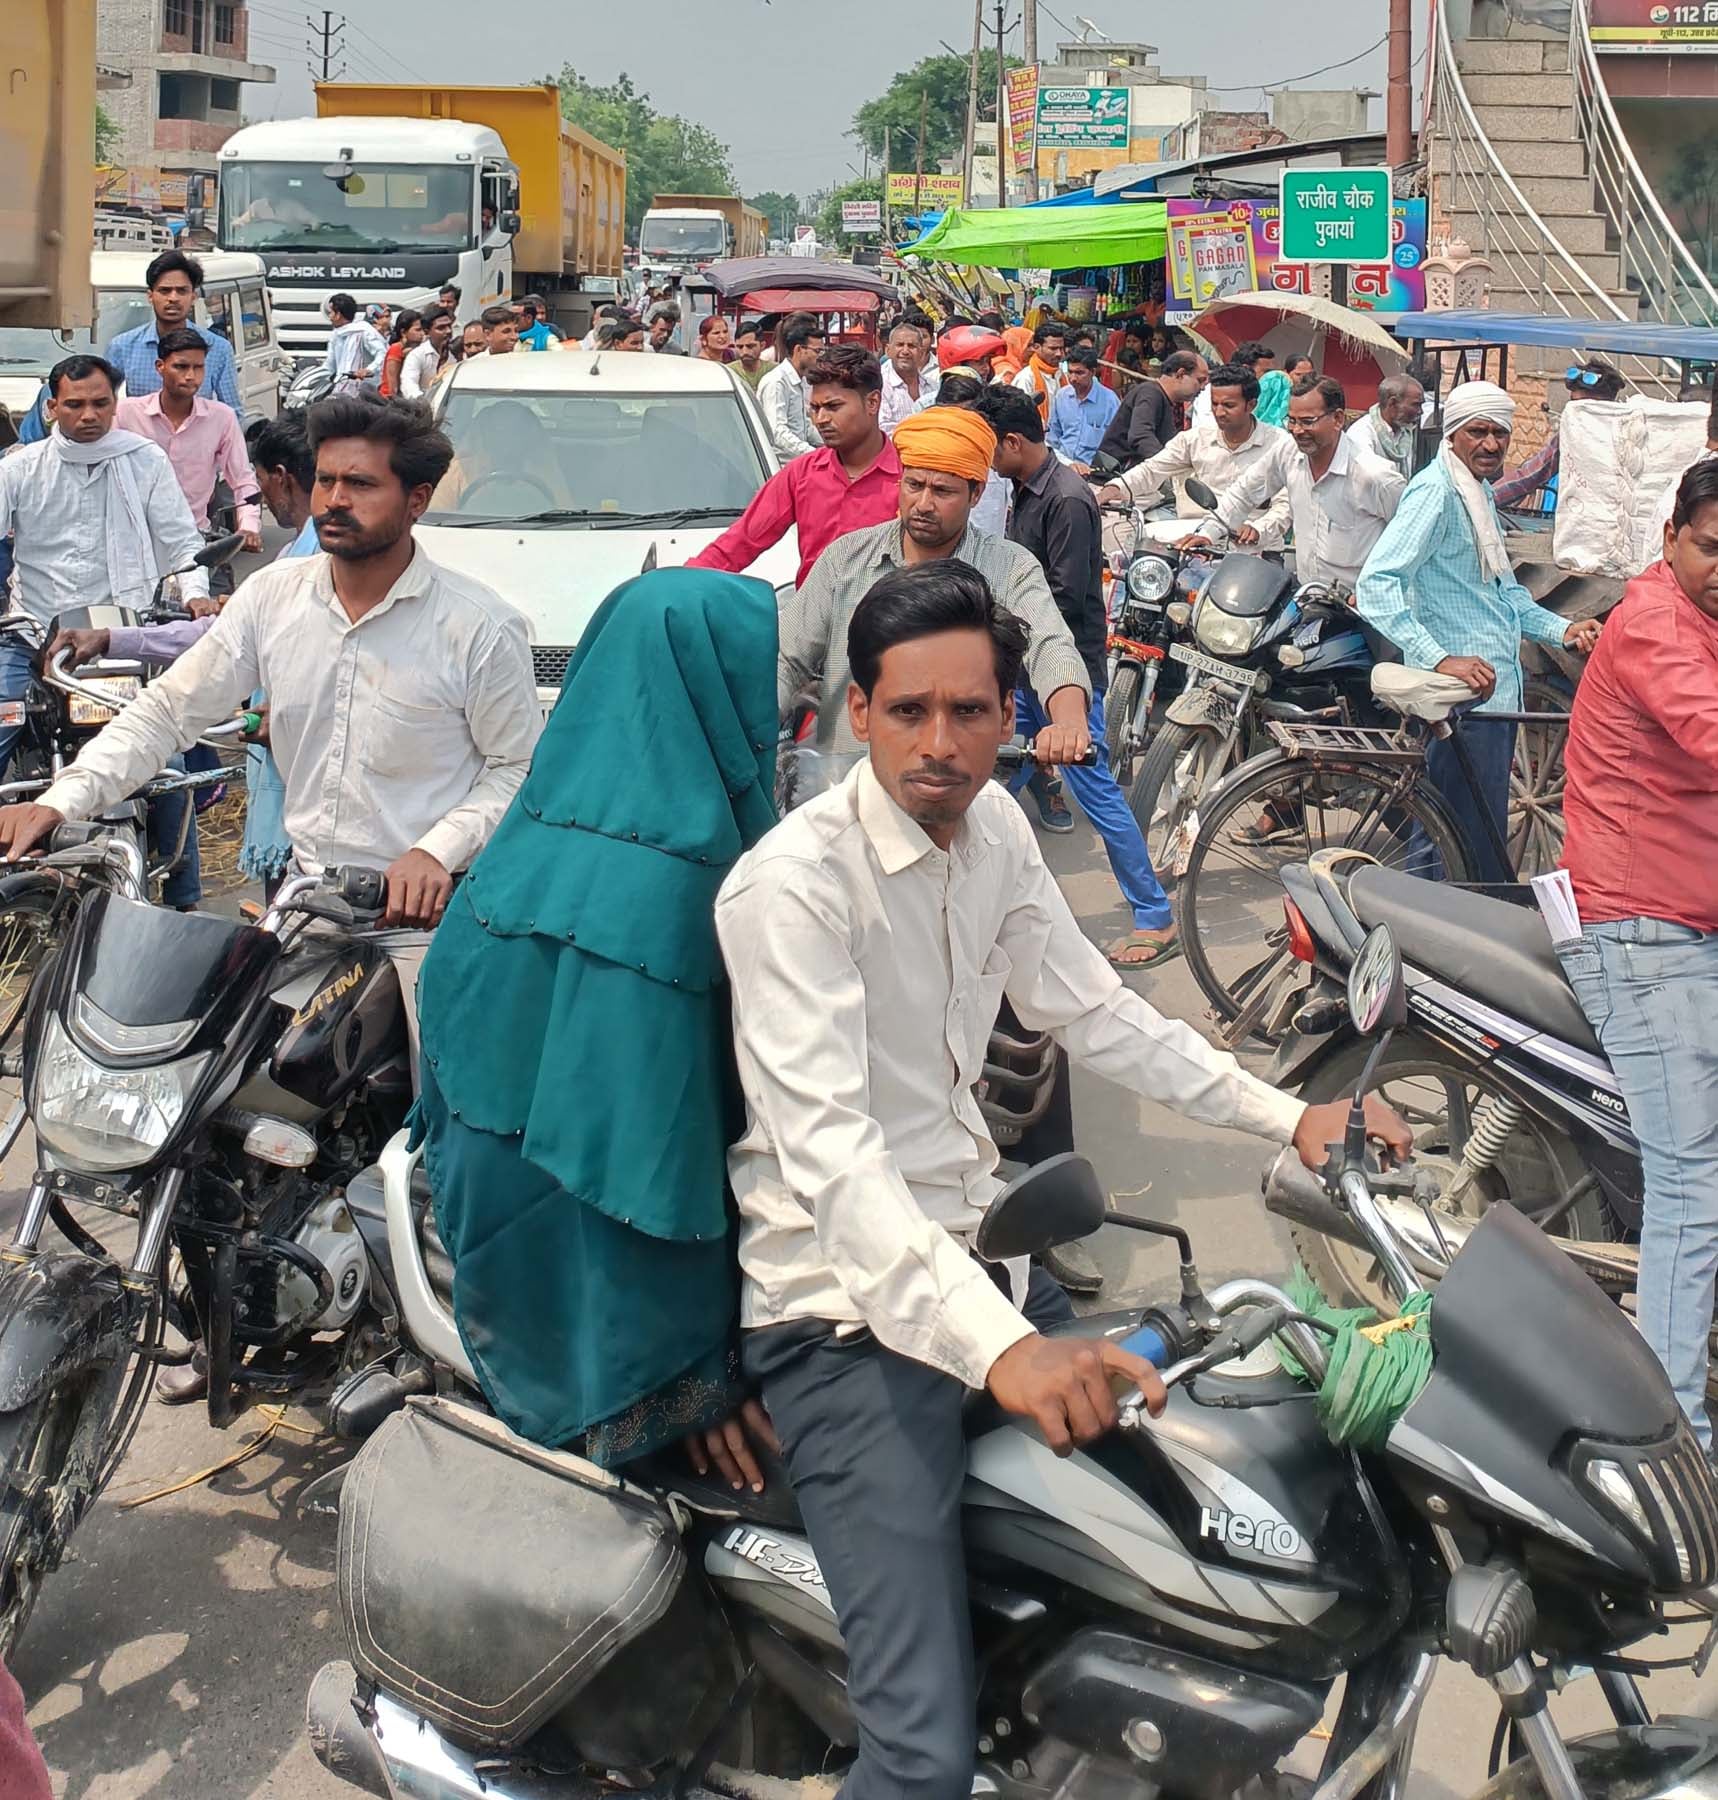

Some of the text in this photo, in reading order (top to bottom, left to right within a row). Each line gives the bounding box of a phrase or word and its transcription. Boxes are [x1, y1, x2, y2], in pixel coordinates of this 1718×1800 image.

[1673, 6, 1700, 23] 112
[1296, 183, 1375, 209] राजीव चौक
[1315, 216, 1355, 247] पुवायां
[1195, 245, 1246, 266] GAGAN
[1400, 250, 1414, 262] 25
[268, 266, 406, 279] ASHOK LEYLAND
[1198, 263, 1245, 273] PAN MASALA
[1272, 263, 1392, 296] गन
[1591, 1089, 1624, 1112] Hero
[1200, 1506, 1300, 1557] Hero
